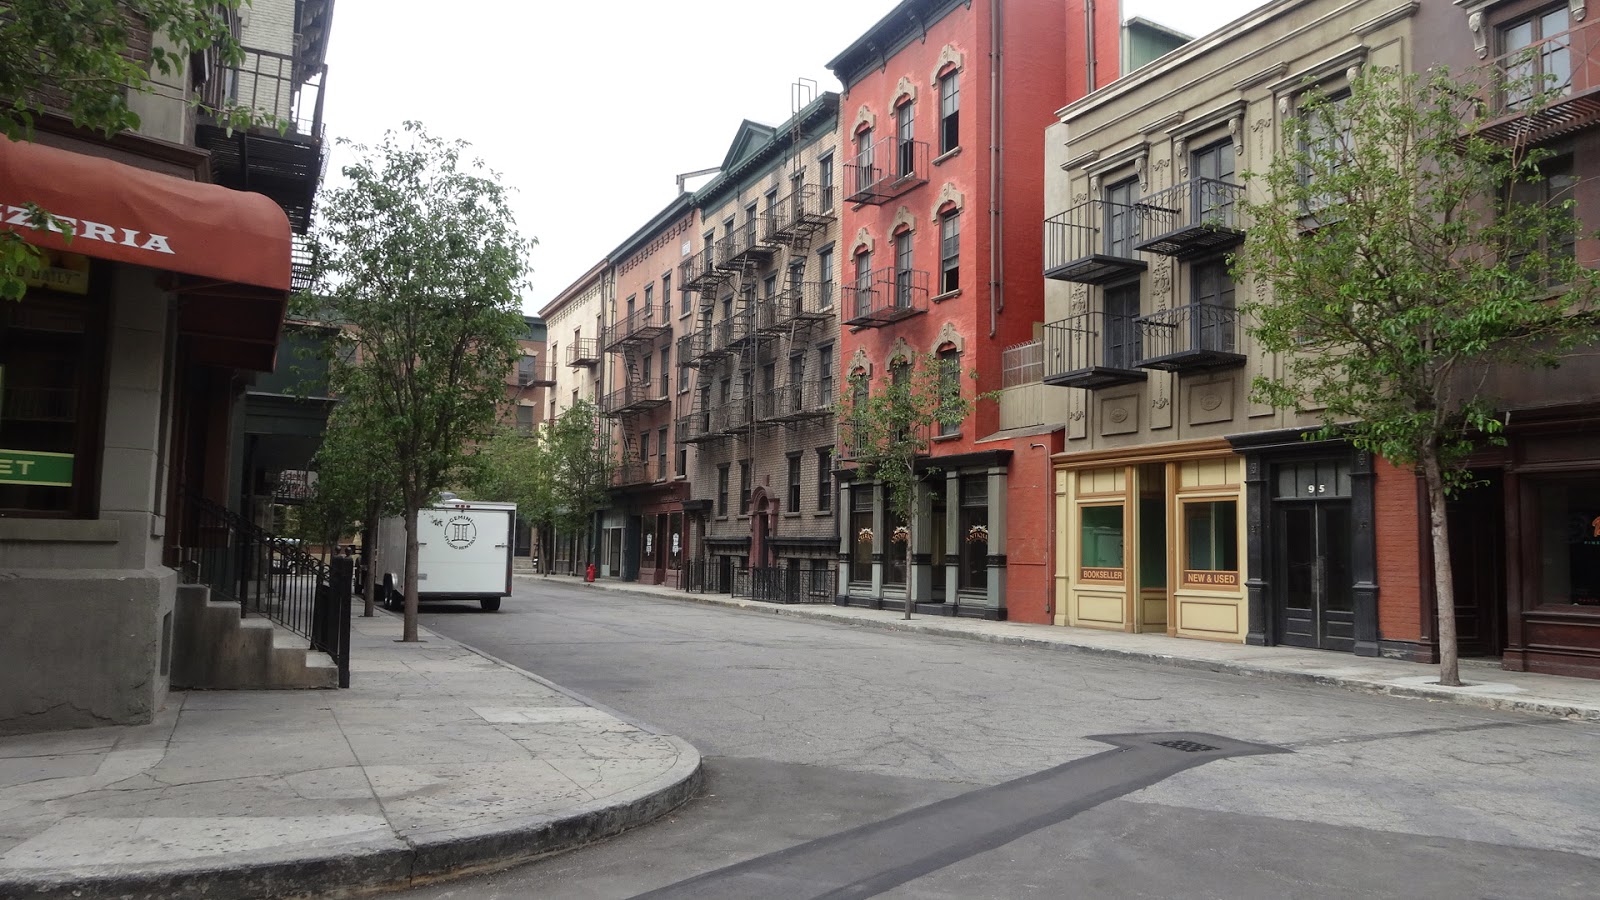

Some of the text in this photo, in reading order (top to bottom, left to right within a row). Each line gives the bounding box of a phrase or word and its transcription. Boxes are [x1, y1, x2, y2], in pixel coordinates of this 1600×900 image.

[0, 204, 176, 254] ZERIA
[1308, 484, 1325, 493] 95
[449, 515, 473, 523] GEMINI
[444, 535, 476, 550] STUDIO RENTALS
[1083, 570, 1123, 580] BOOKSELLER
[1187, 573, 1235, 584] NEW & USED
